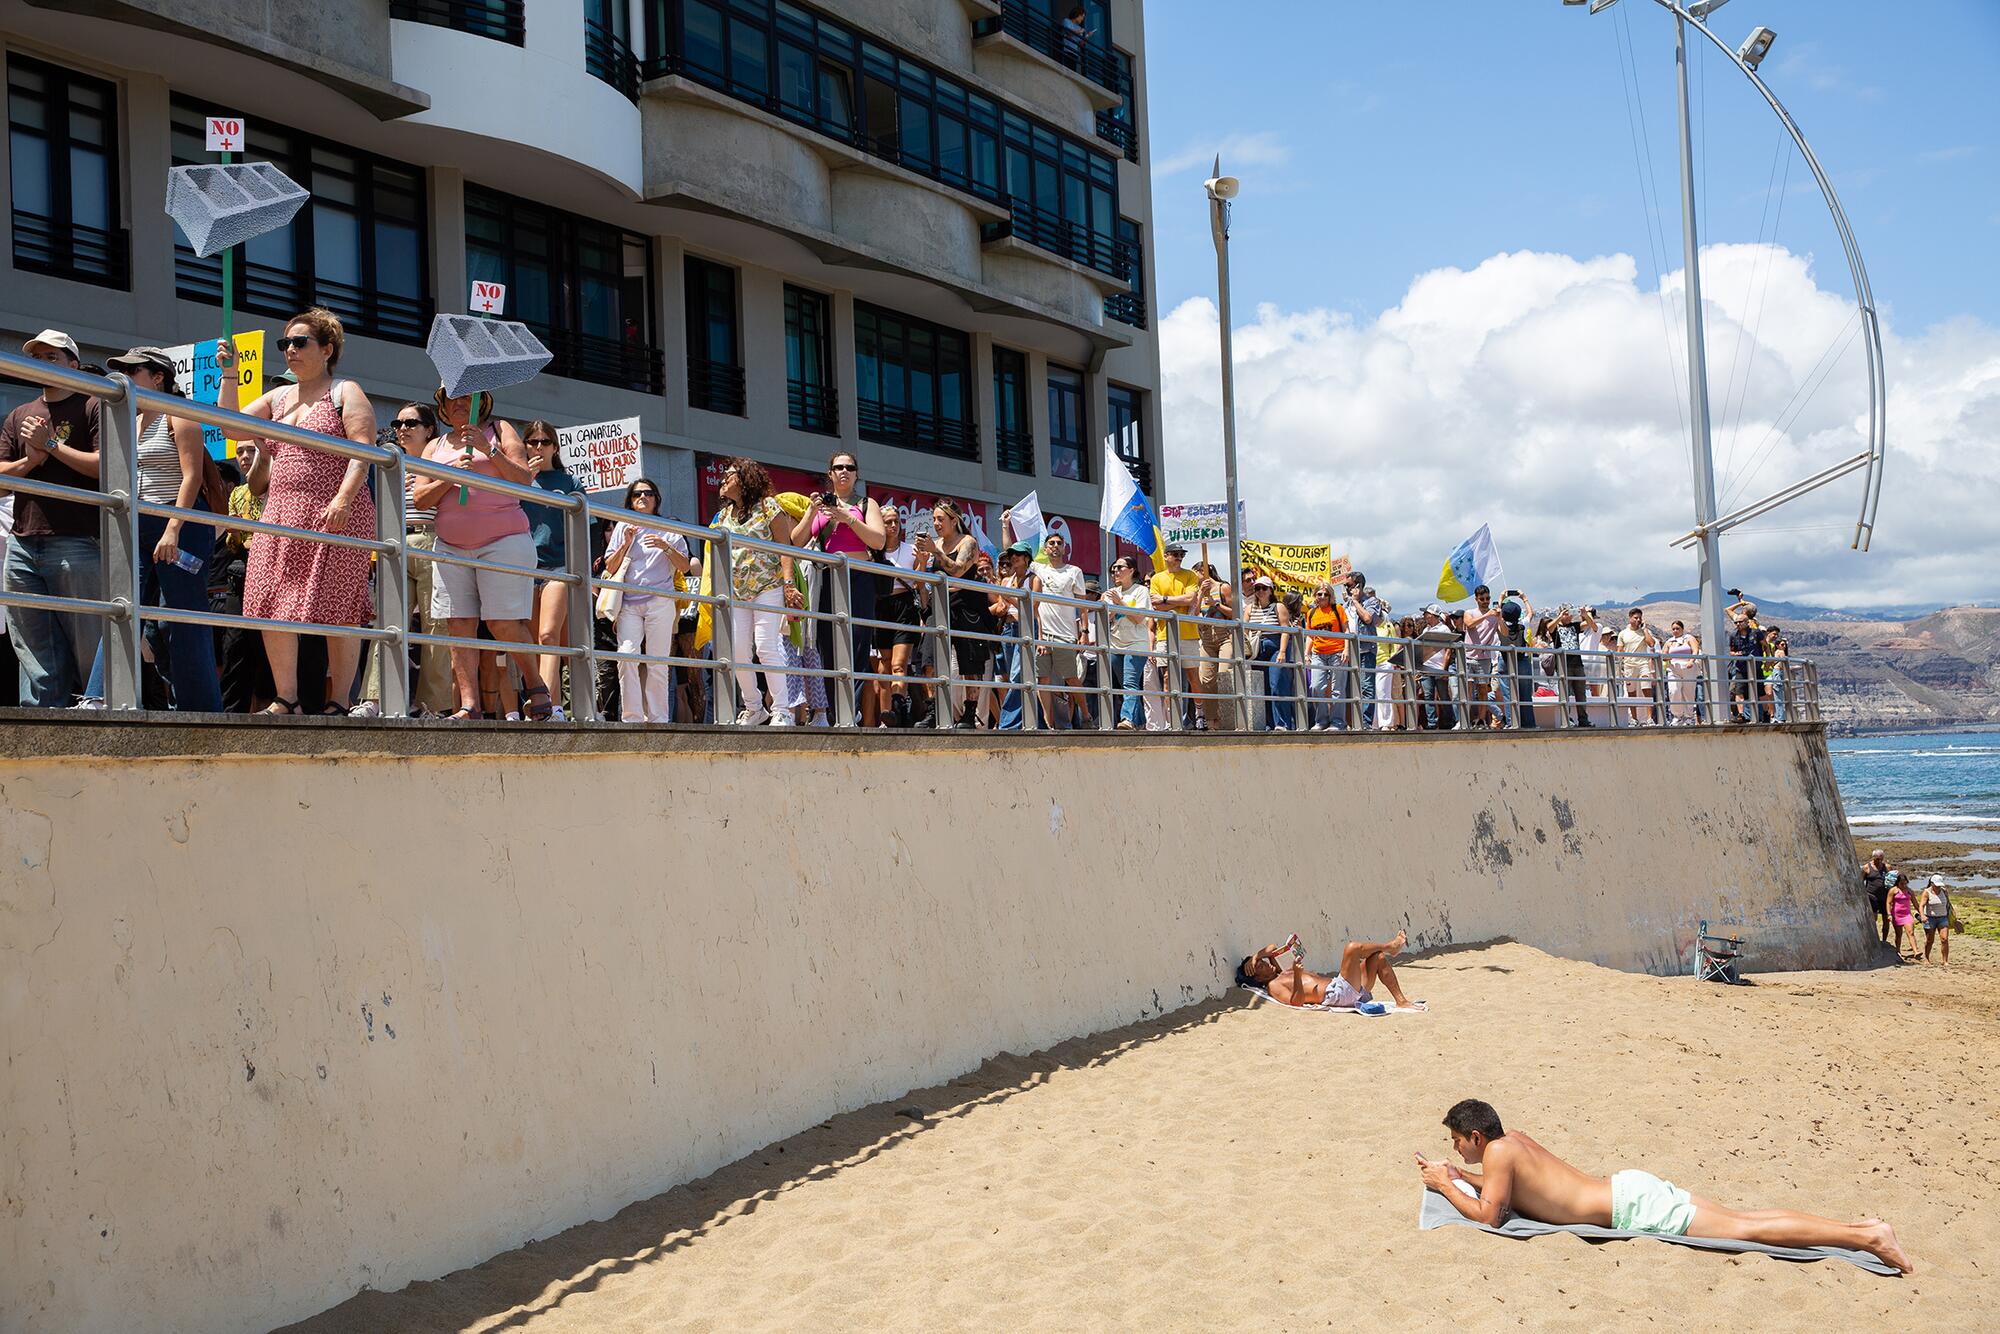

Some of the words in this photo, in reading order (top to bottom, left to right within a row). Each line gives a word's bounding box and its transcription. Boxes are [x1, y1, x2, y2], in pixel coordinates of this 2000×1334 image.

[211, 120, 239, 135] NO
[476, 283, 500, 299] NO
[240, 349, 257, 362] ARA
[185, 381, 197, 395] EL
[204, 369, 252, 391] PULO
[204, 428, 226, 444] PRE
[560, 433, 572, 447] EN
[577, 424, 622, 442] CANARIAS
[569, 445, 587, 457] LOS
[588, 433, 639, 458] ALQUILERES
[567, 460, 591, 475] STÁN
[613, 451, 636, 467] ALTOS
[588, 474, 598, 487] EL
[597, 467, 629, 488] TEIDE
